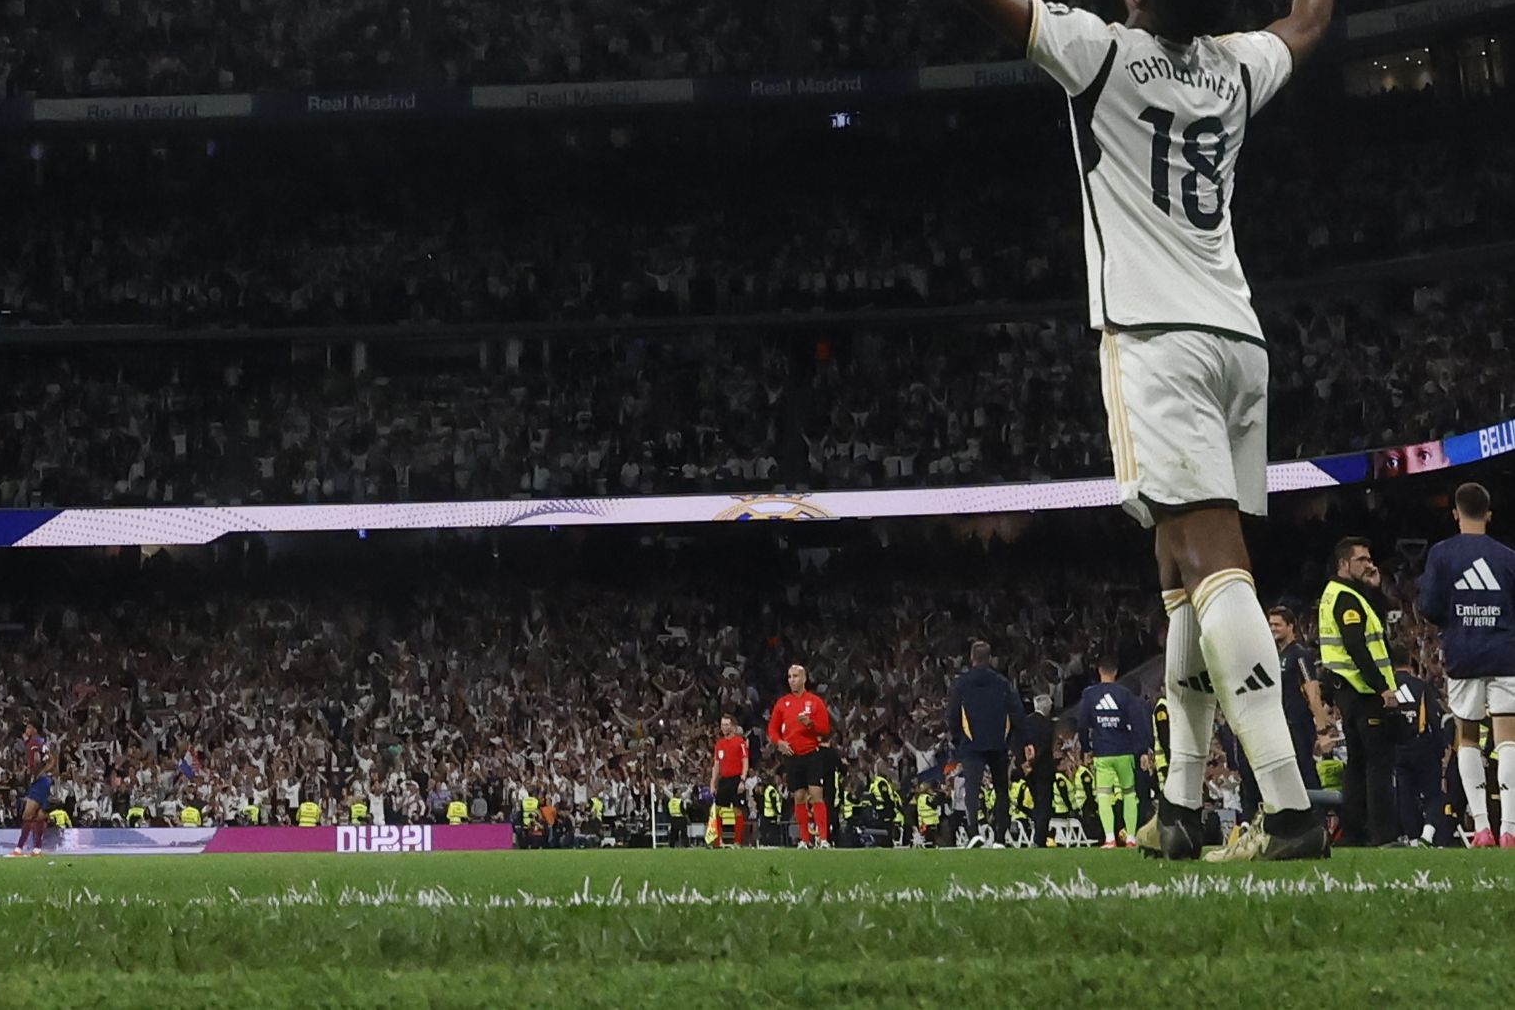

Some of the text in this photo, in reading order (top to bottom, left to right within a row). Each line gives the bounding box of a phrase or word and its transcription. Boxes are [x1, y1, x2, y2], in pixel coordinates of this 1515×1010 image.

[750, 76, 862, 95] Real Madrid
[307, 92, 416, 111] Real Madrid
[1137, 106, 1230, 231] 18
[1455, 603, 1501, 616] Emirates
[336, 824, 431, 852] DUBAI
